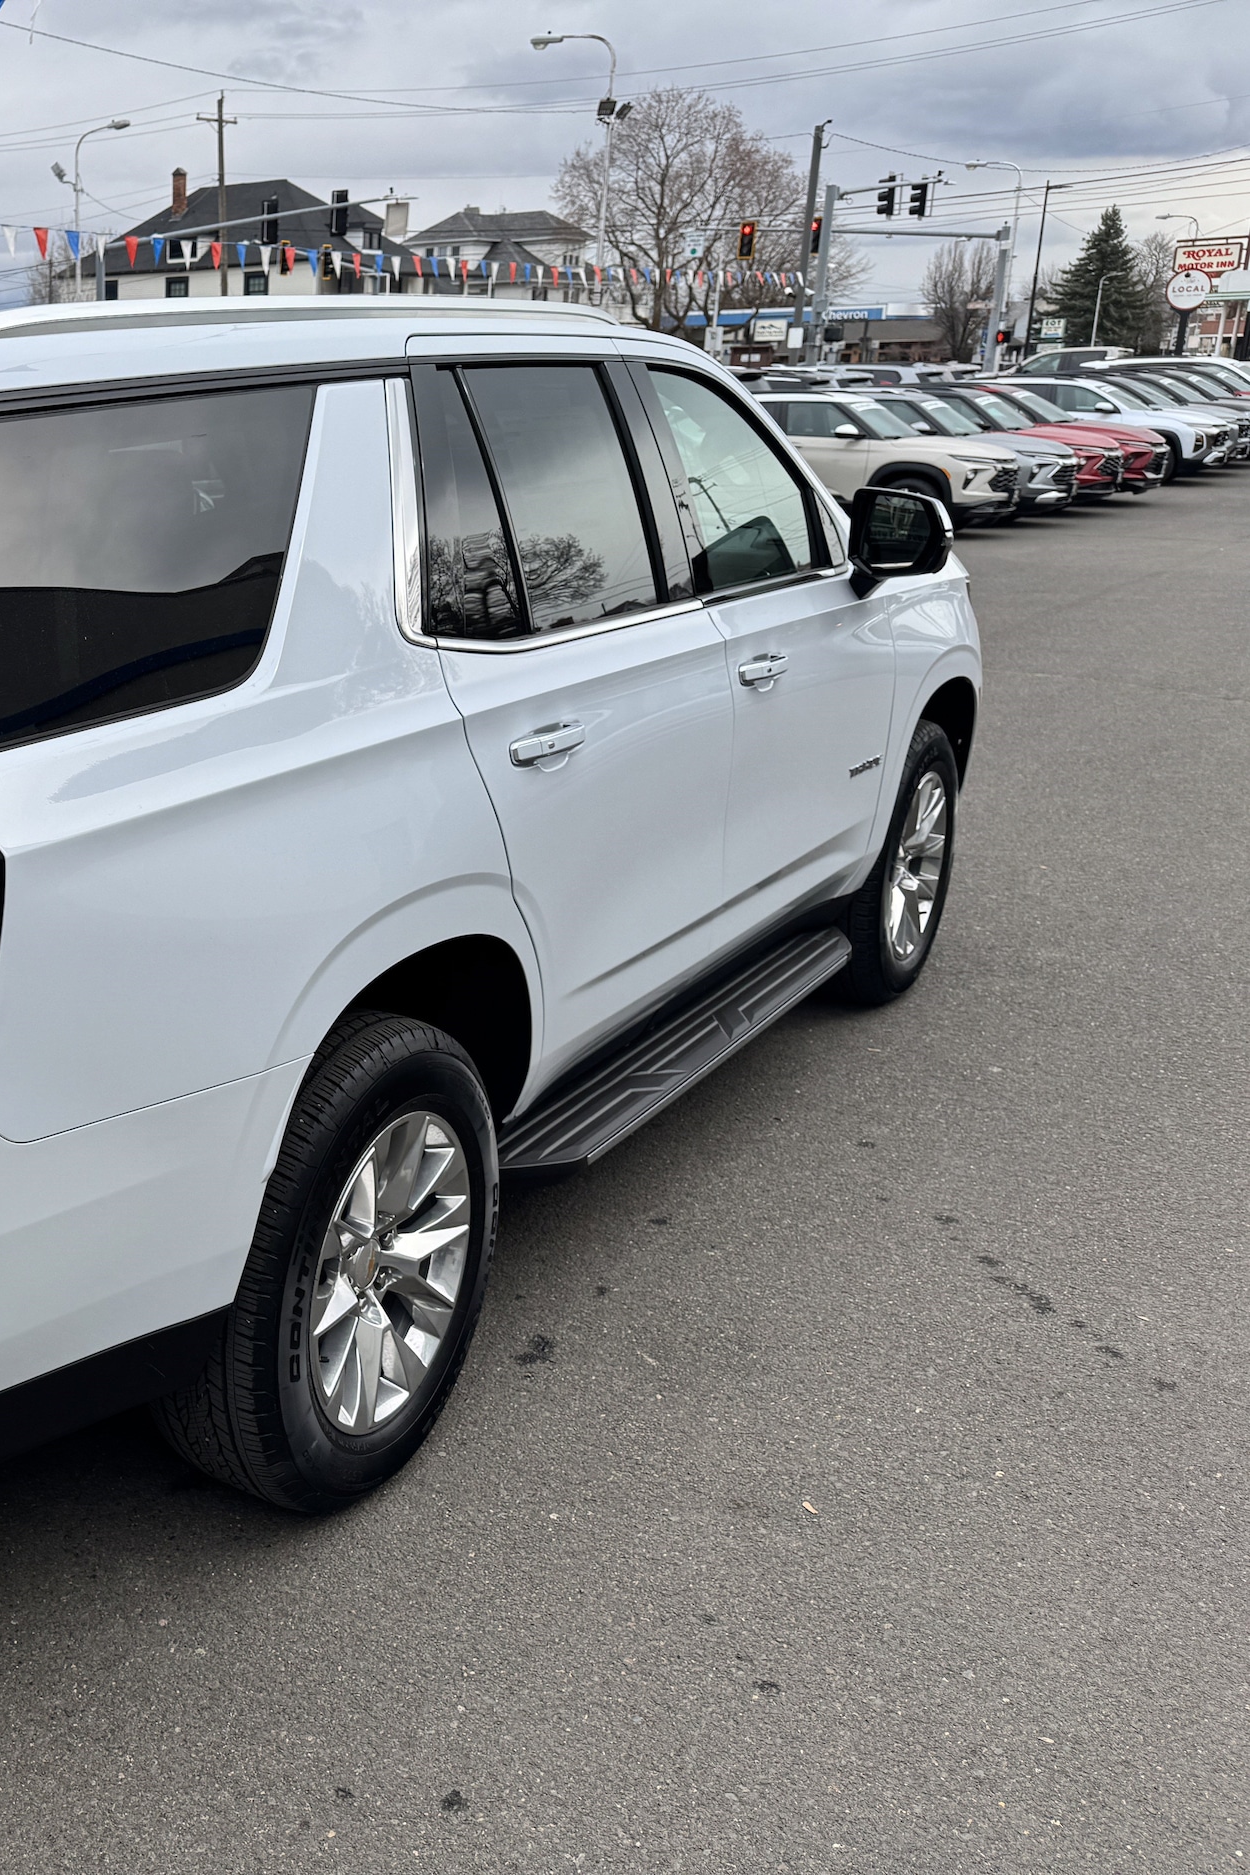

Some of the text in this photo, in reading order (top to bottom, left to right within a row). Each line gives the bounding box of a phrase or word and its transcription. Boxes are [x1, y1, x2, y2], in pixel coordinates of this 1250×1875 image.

[1182, 247, 1233, 261] ROYAL
[1177, 260, 1235, 271] MOTOR INN
[1172, 285, 1205, 293] LOCAL
